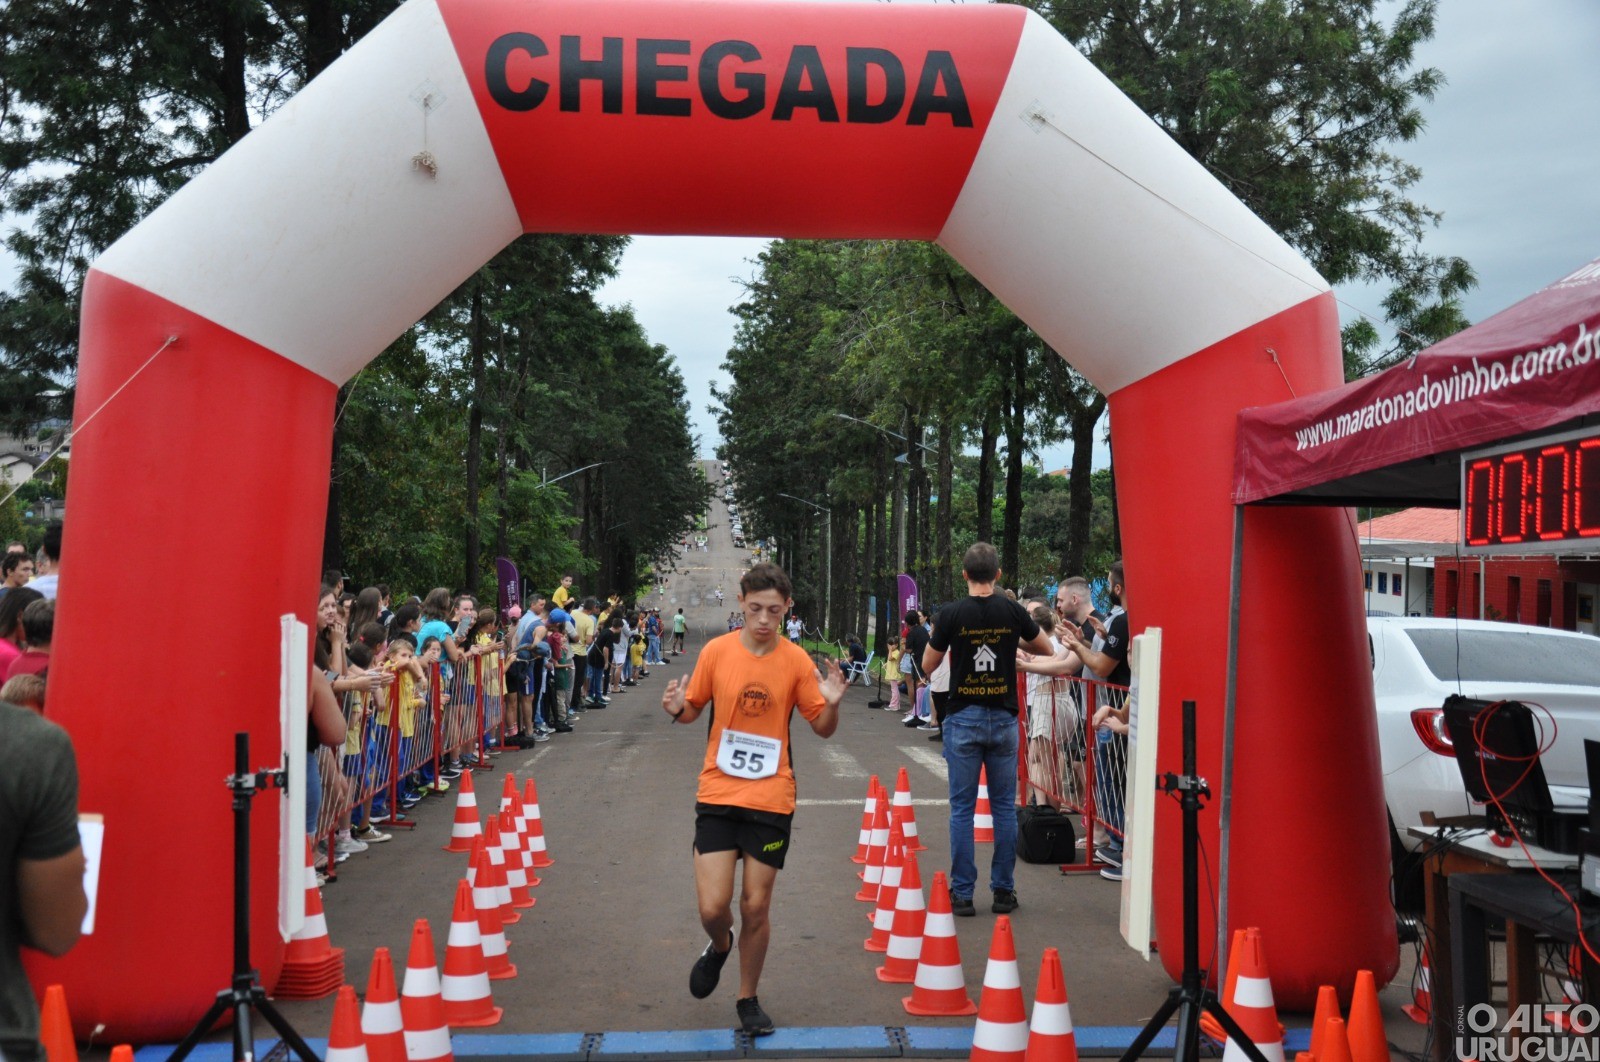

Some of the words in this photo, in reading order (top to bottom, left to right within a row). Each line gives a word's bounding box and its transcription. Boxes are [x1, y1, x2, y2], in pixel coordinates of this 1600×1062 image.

[484, 31, 974, 128] CHEGADA
[957, 686, 986, 695] PONTO
[730, 749, 765, 773] 55
